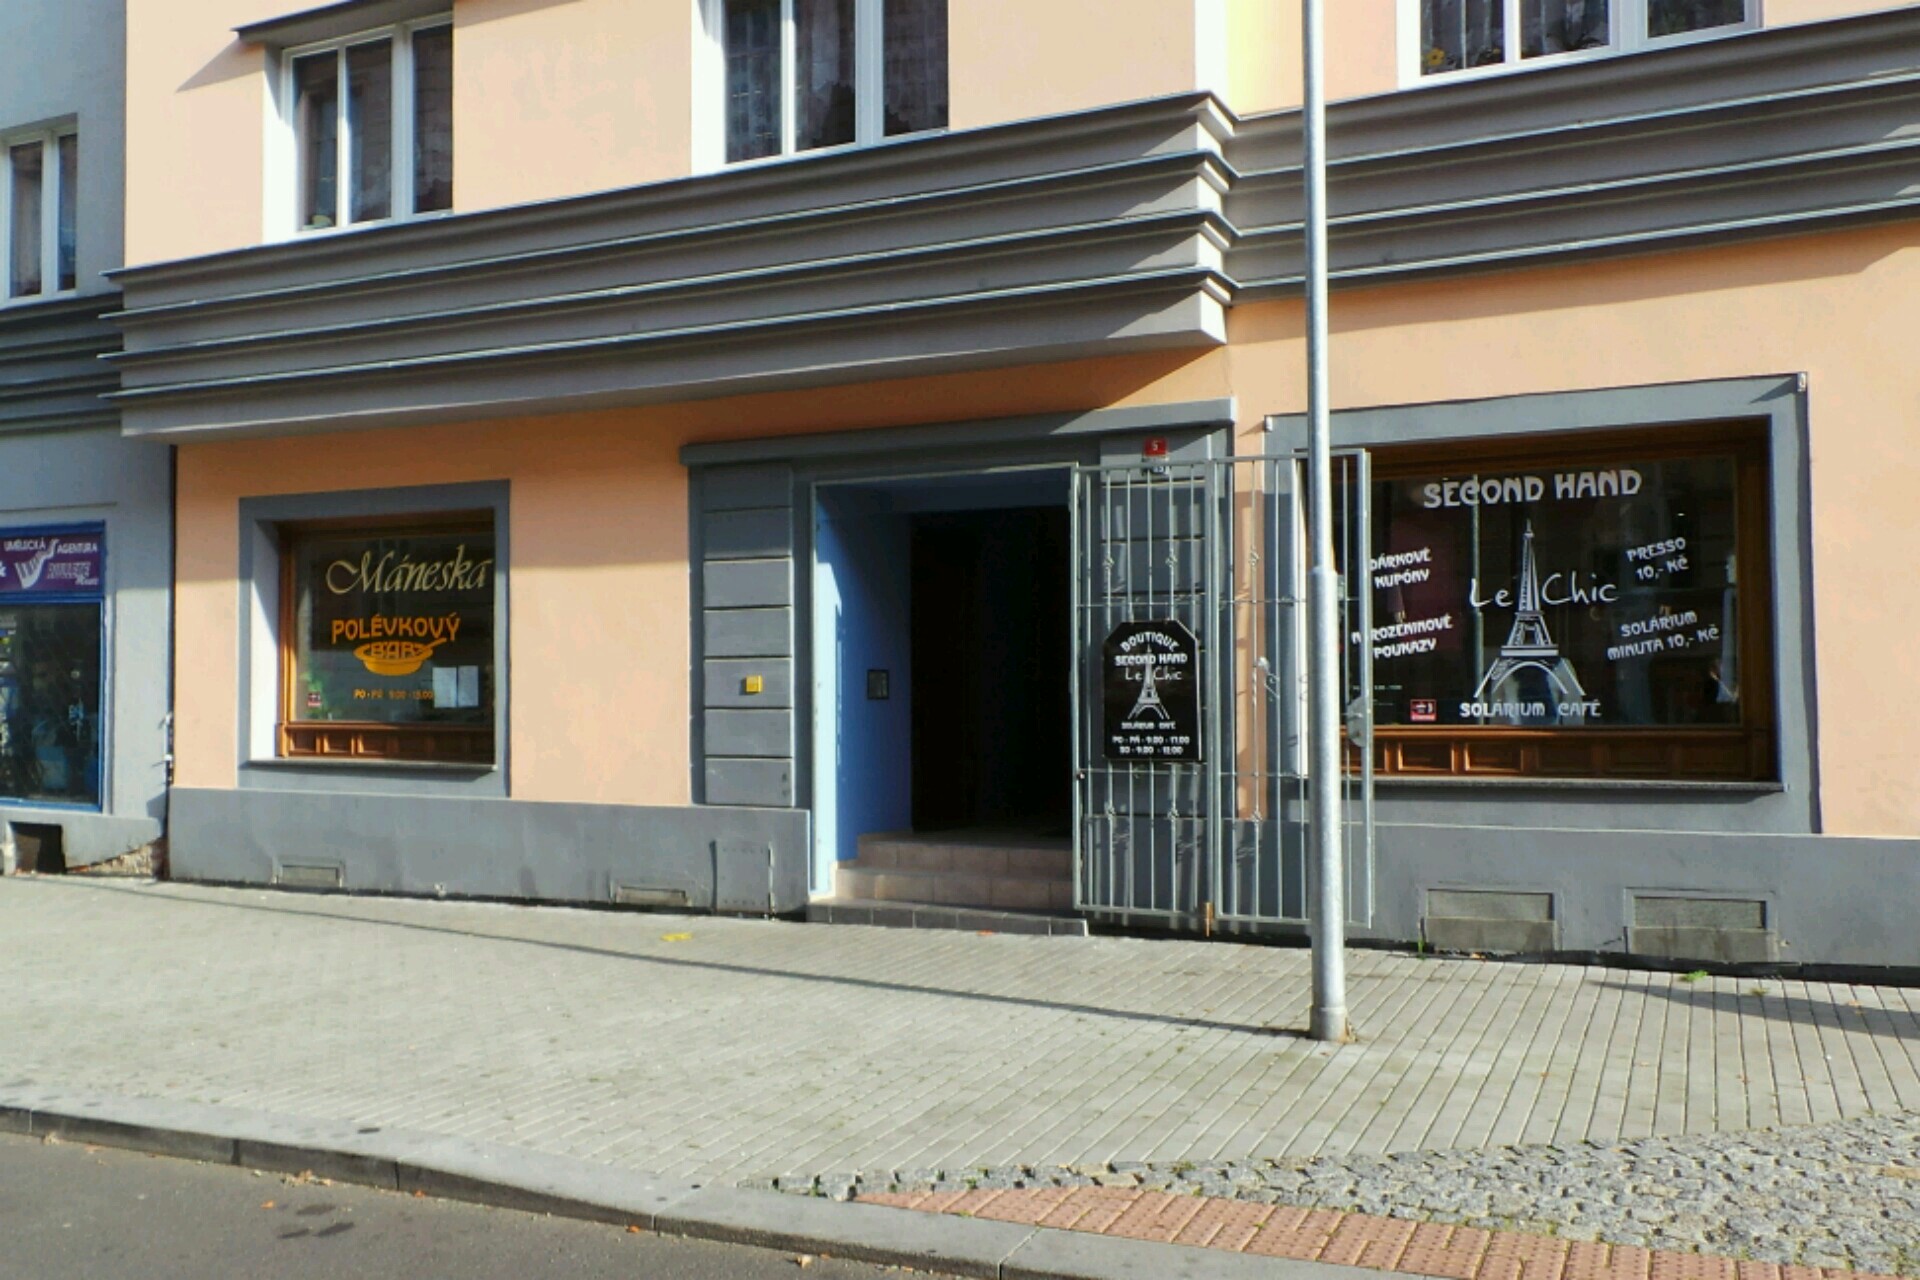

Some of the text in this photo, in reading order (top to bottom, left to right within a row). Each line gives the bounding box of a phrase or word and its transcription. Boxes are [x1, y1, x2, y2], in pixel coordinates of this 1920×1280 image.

[1423, 469, 1642, 508] SECOND HAND
[57, 543, 98, 553] AGENTURA
[1626, 537, 1686, 561] PRESSO
[325, 544, 493, 594] Máneska
[1374, 568, 1430, 589] KUPÓNY
[1469, 571, 1620, 607] Le Chic
[332, 612, 461, 644] POLÉVKOVÝ
[1351, 612, 1454, 644] NROZENINOVÉ
[1620, 610, 1698, 637] SOLÁRIUM
[371, 642, 414, 660] BAR
[1120, 631, 1180, 653] BOUTIQUE
[1373, 637, 1437, 659] POUKAZY
[1607, 638, 1664, 660] MINUTA
[1114, 652, 1188, 667] SECOND HAND
[1125, 665, 1183, 681] Le Chic
[1460, 699, 1602, 718] SOLÁRIUM CAFÉ
